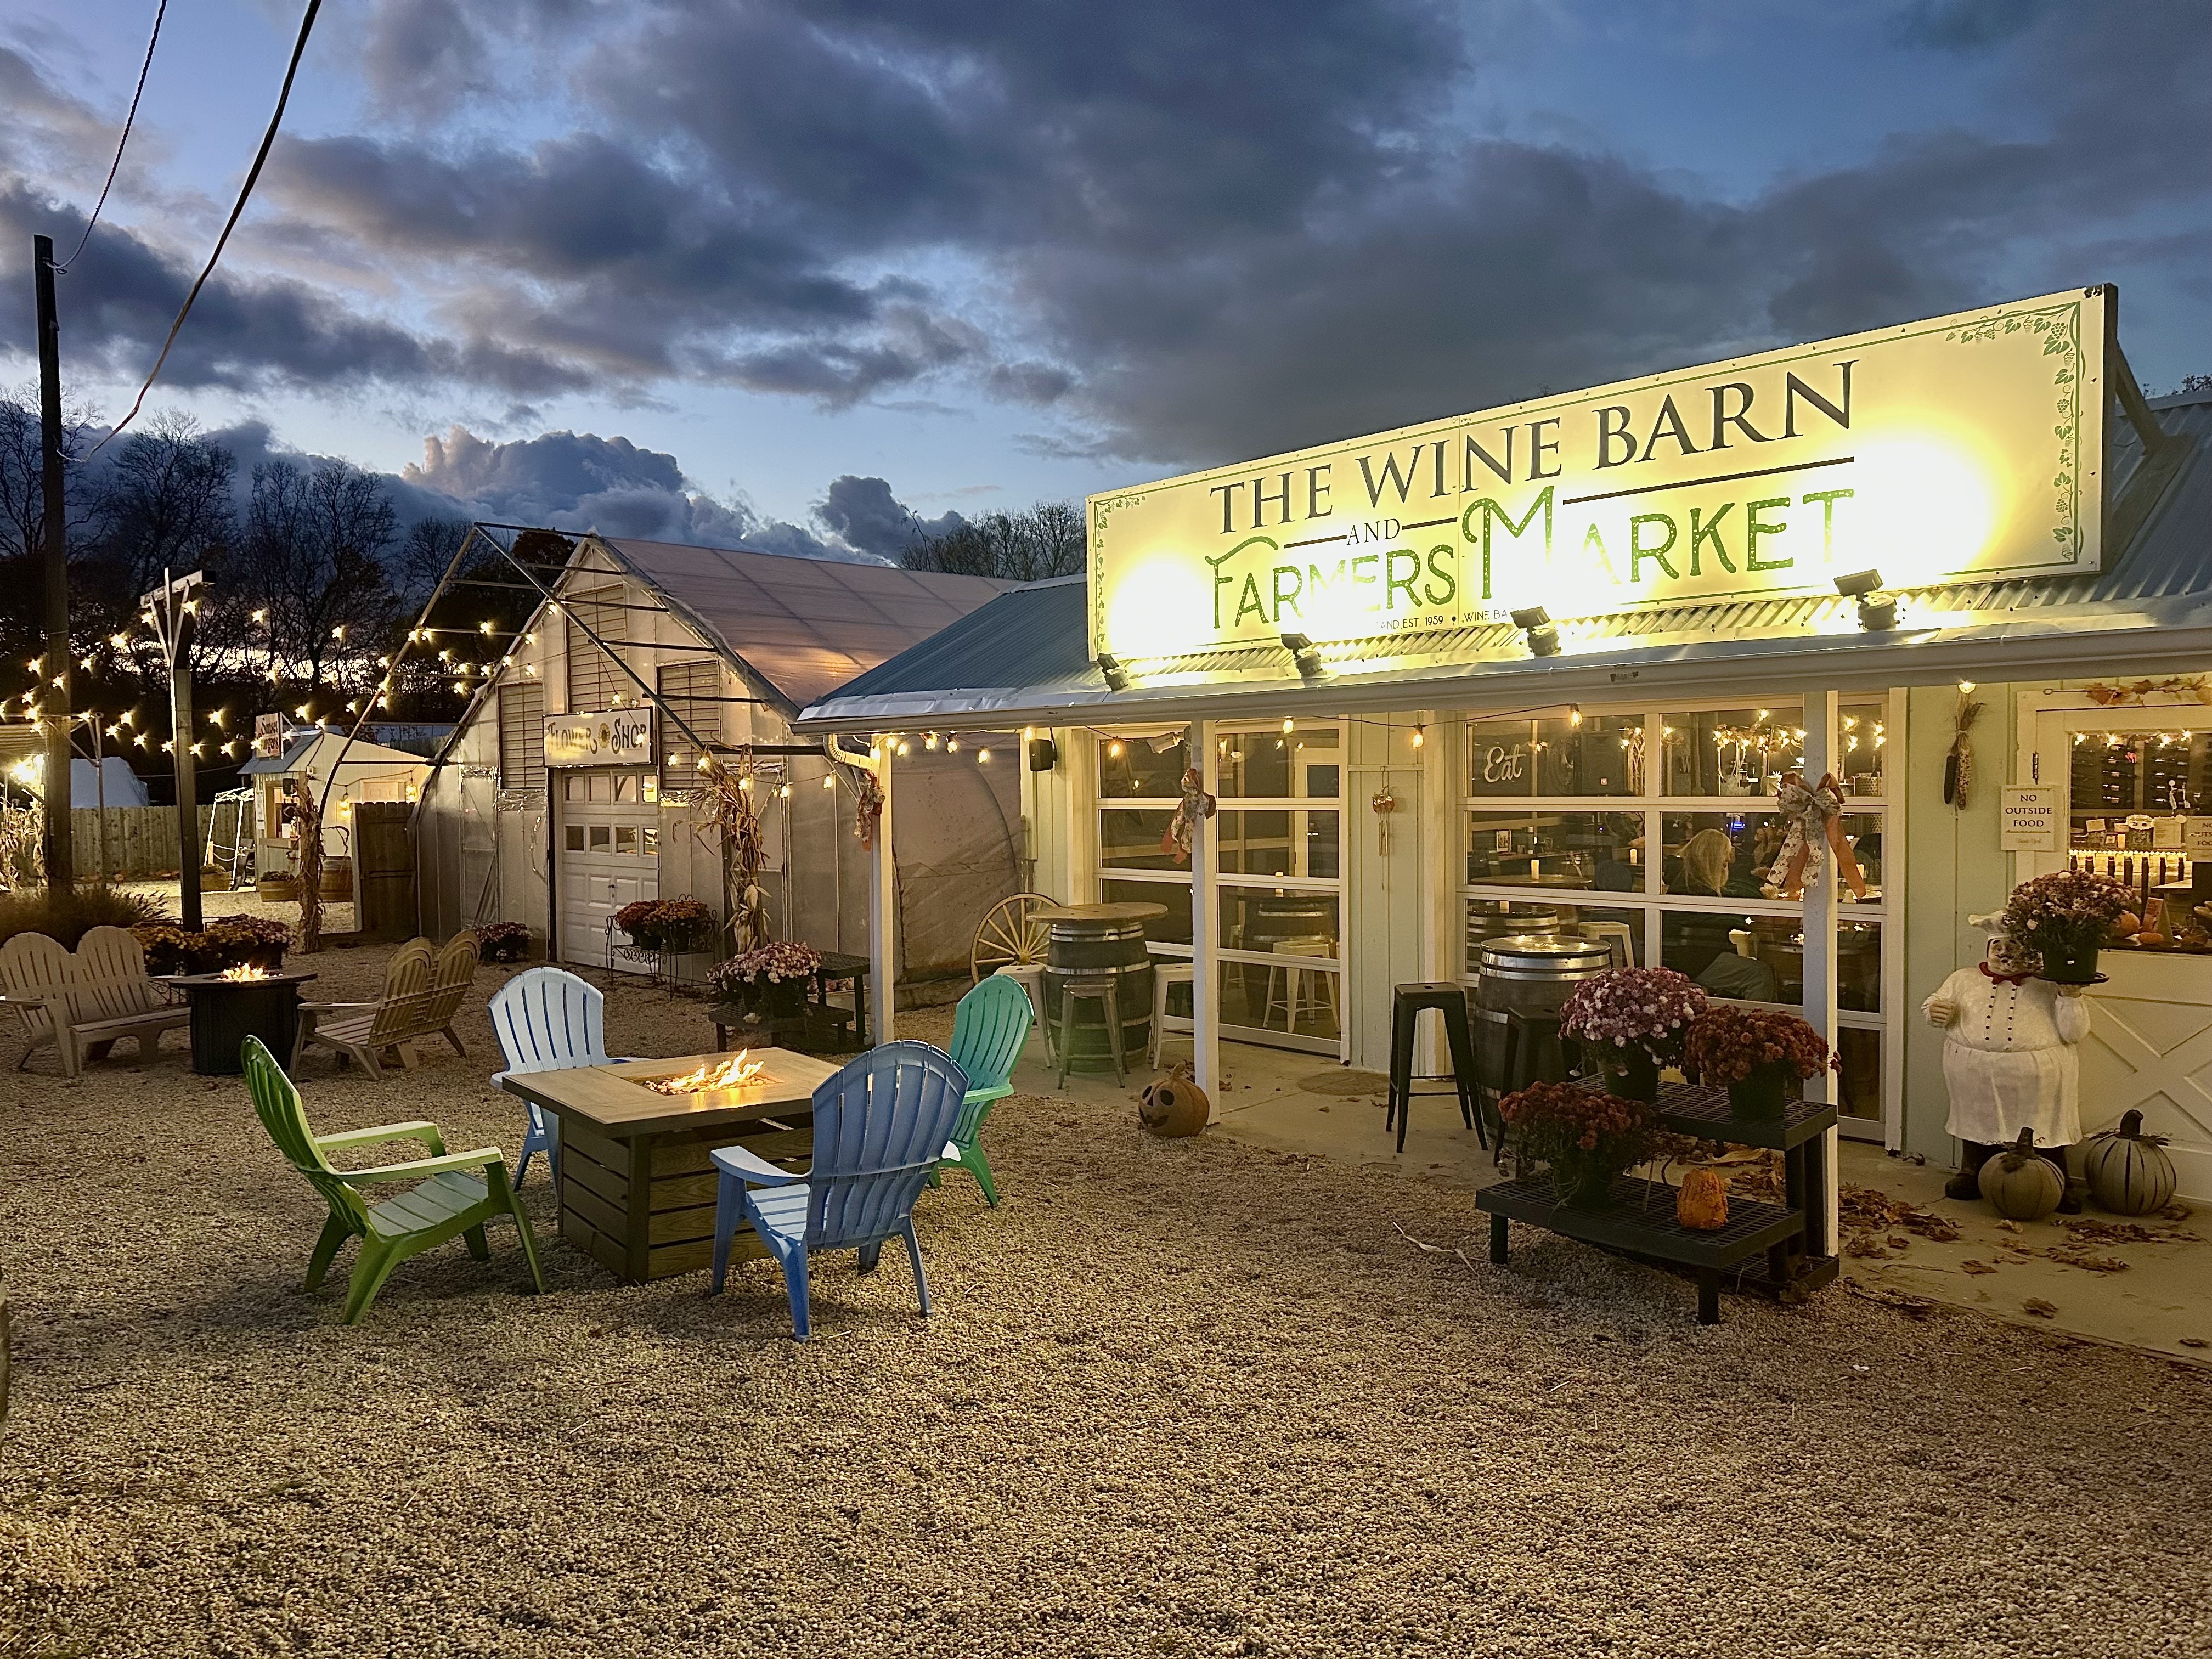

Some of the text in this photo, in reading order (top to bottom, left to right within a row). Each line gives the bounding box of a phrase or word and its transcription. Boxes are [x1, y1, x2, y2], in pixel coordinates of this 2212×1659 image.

[1210, 359, 1860, 534] THE WINE BARN
[1346, 518, 1400, 545] AND
[1425, 616, 1443, 626] 1959
[1464, 611, 1489, 622] WINE
[1484, 743, 1526, 783] Eat
